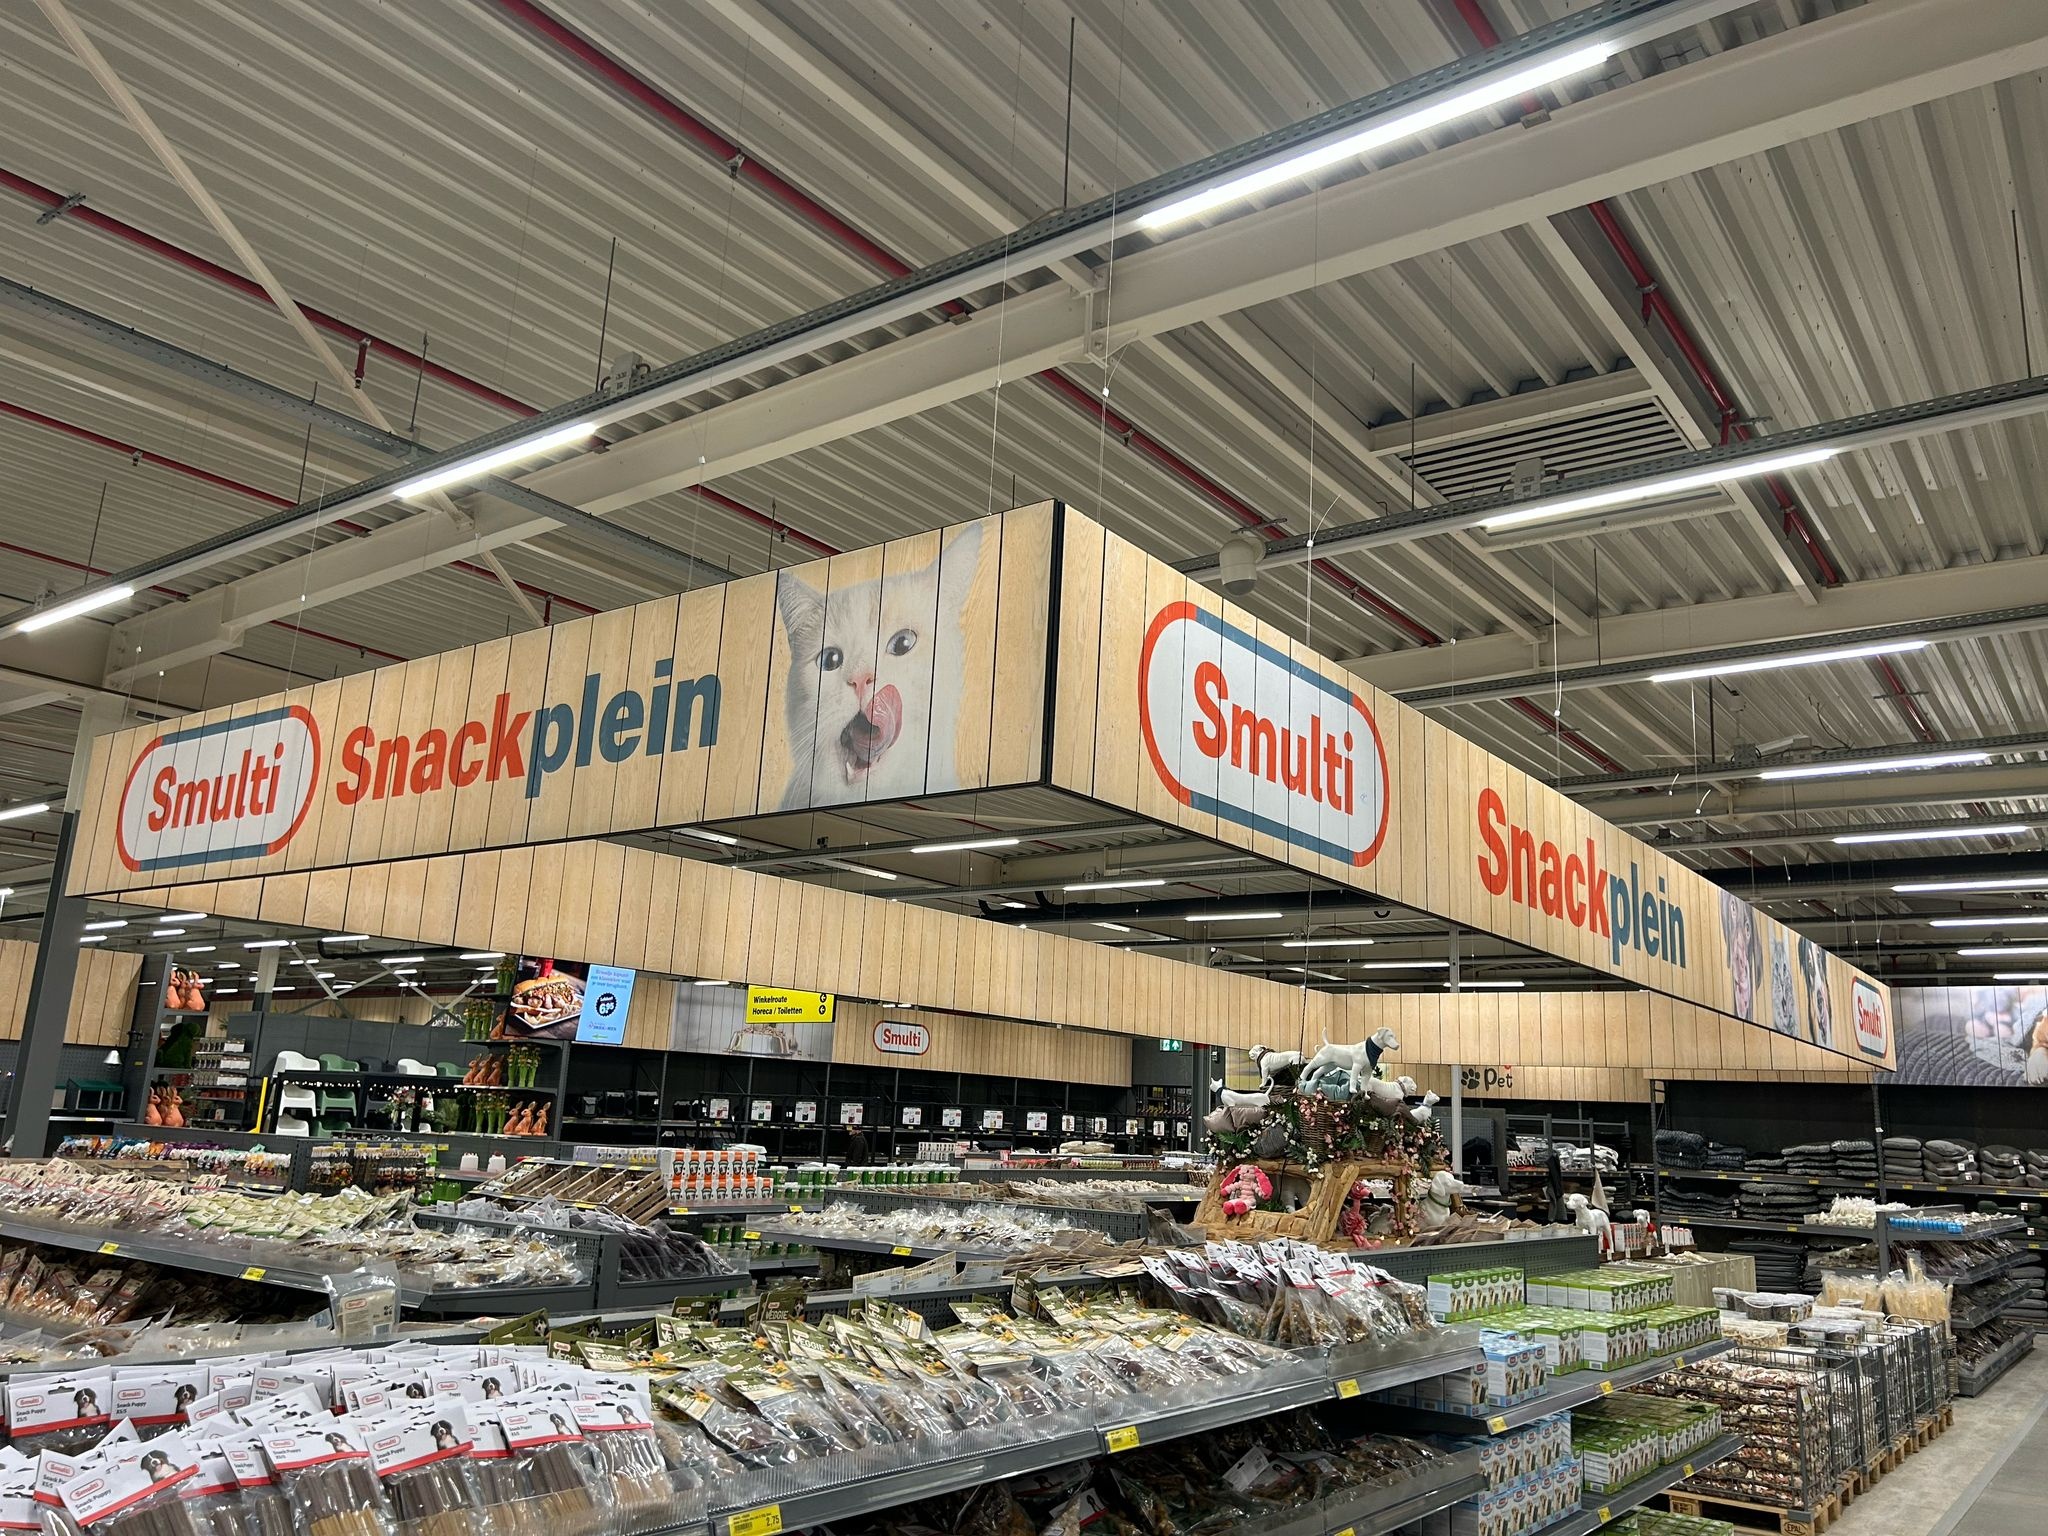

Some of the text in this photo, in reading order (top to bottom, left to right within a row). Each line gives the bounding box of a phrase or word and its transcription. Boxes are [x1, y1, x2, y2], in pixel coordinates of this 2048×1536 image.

[336, 659, 723, 805] Snackplein
[1191, 661, 1354, 816] Smulti
[148, 742, 283, 832] Smulti
[1476, 787, 1687, 969] Snackplein
[753, 995, 788, 1004] Winkelroute
[752, 1007, 772, 1016] Horeca
[777, 1007, 803, 1015] Toiletten
[1857, 995, 1882, 1039] Smulti
[883, 1028, 921, 1047] Smulti
[1484, 1068, 1513, 1091] Pet
[766, 1310, 789, 1320] VEGGIE
[75, 1481, 99, 1497] Smulti
[766, 1515, 780, 1527] 2,75
